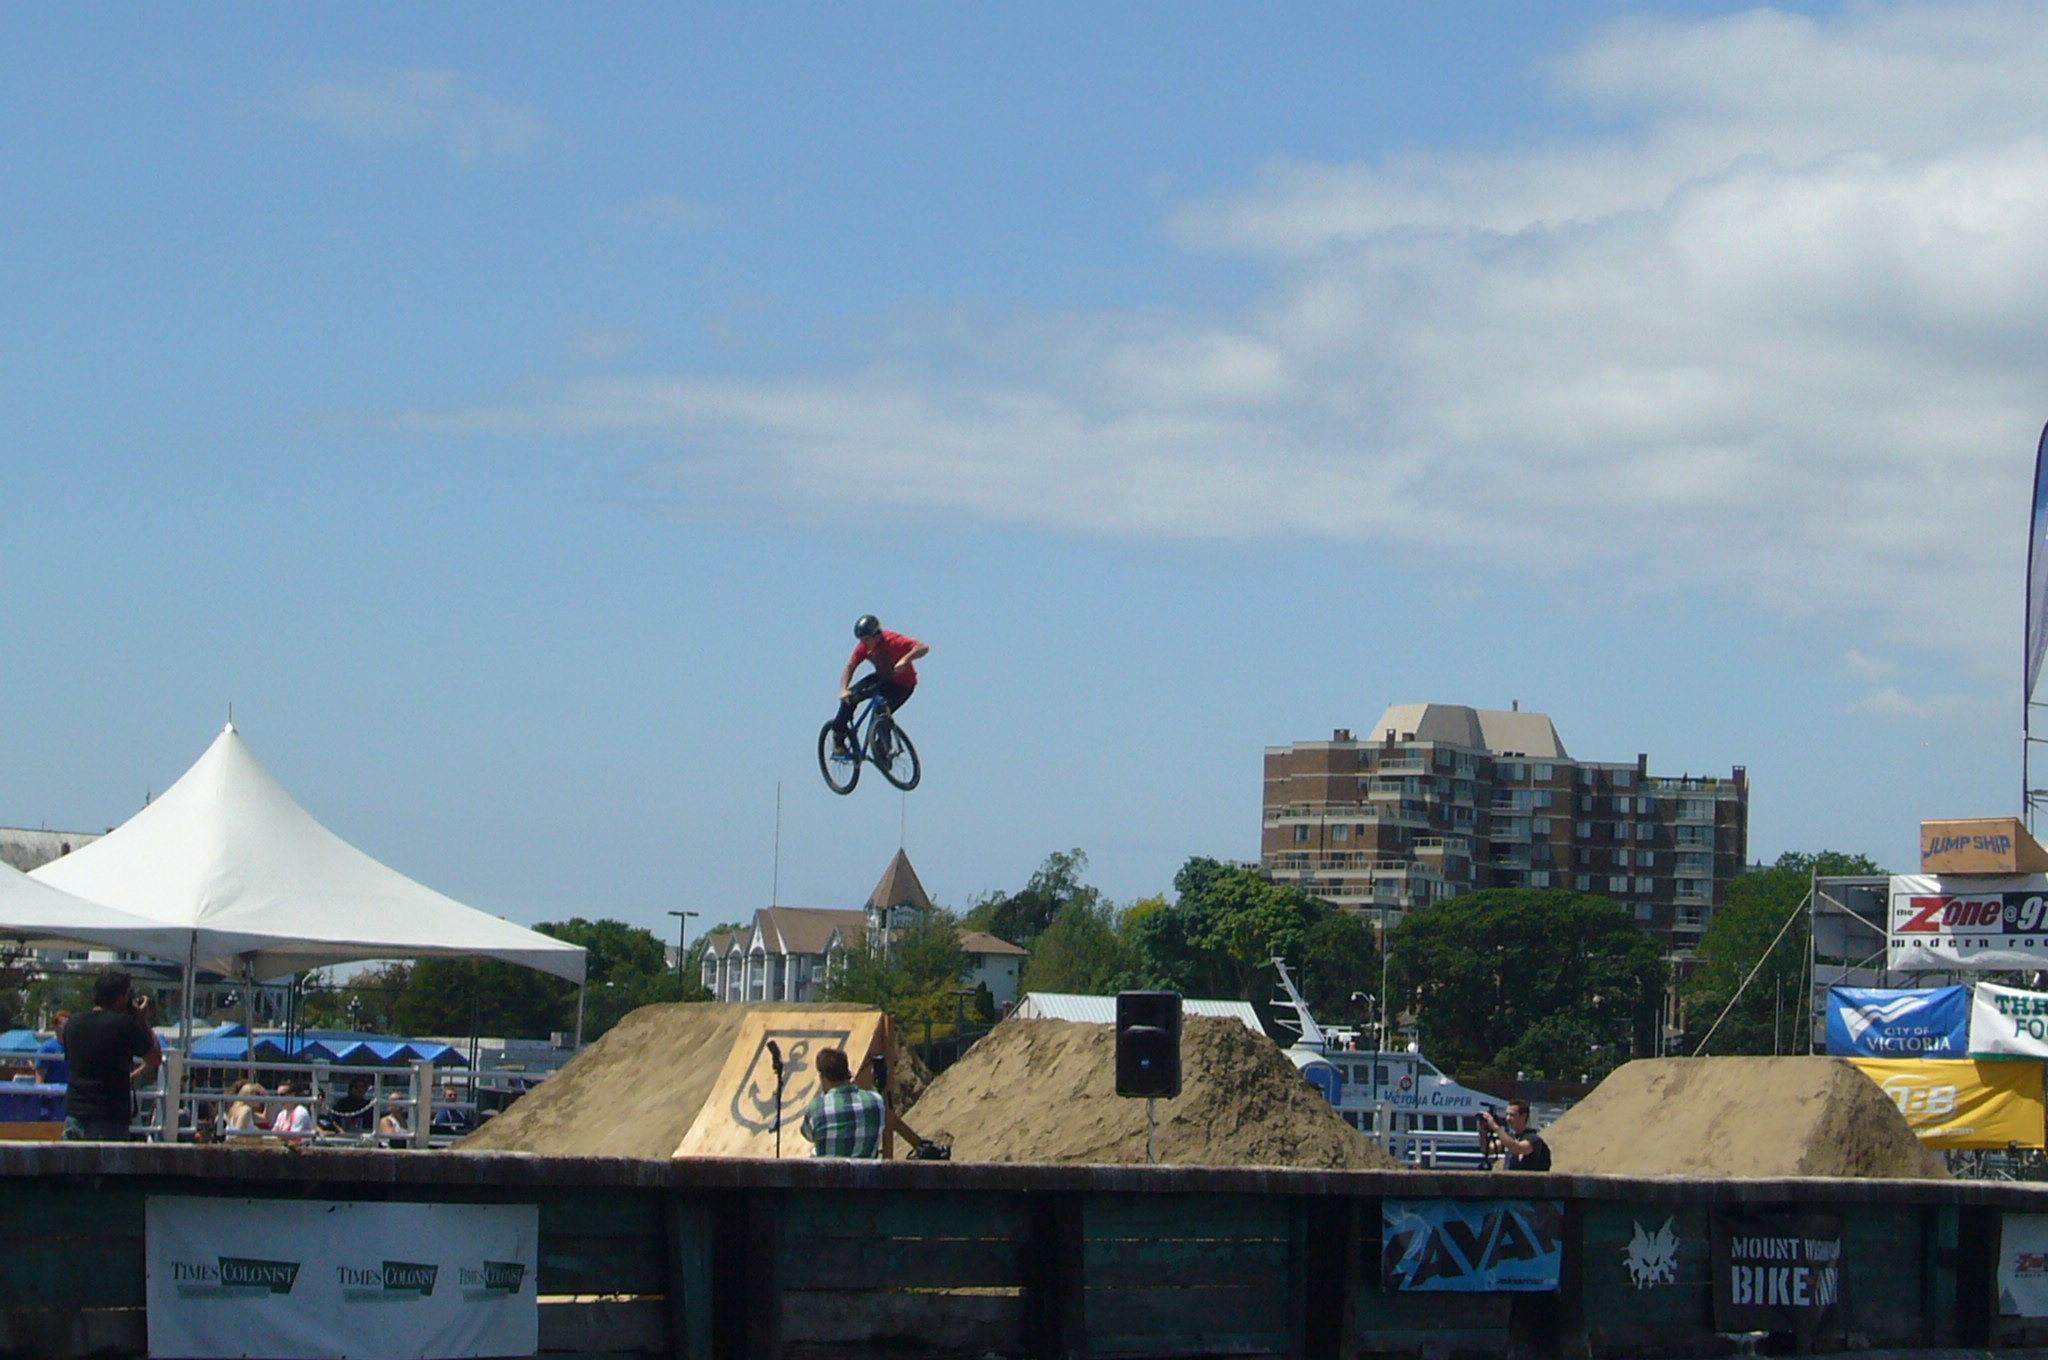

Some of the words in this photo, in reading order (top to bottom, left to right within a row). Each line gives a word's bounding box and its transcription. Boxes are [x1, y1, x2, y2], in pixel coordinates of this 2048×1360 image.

[1923, 835, 1971, 859] JUMP
[1973, 835, 2011, 855] SHIP
[1896, 908, 1914, 917] the
[1896, 896, 2001, 932] Zone
[1891, 938, 1990, 948] modern
[1884, 1027, 1910, 1036] CITY
[1914, 1026, 1930, 1035] OF
[2014, 1017, 2048, 1041] FO
[1866, 1036, 1952, 1051] VICTORIA
[1431, 1090, 1473, 1107] CLIPPER
[1731, 1236, 1800, 1260] MOUNT
[171, 1260, 219, 1281] TIMES
[222, 1263, 295, 1284] COLONIST
[336, 1264, 382, 1286] TIMES
[384, 1266, 435, 1286] COLONIST
[1731, 1264, 1811, 1306] BIKE
